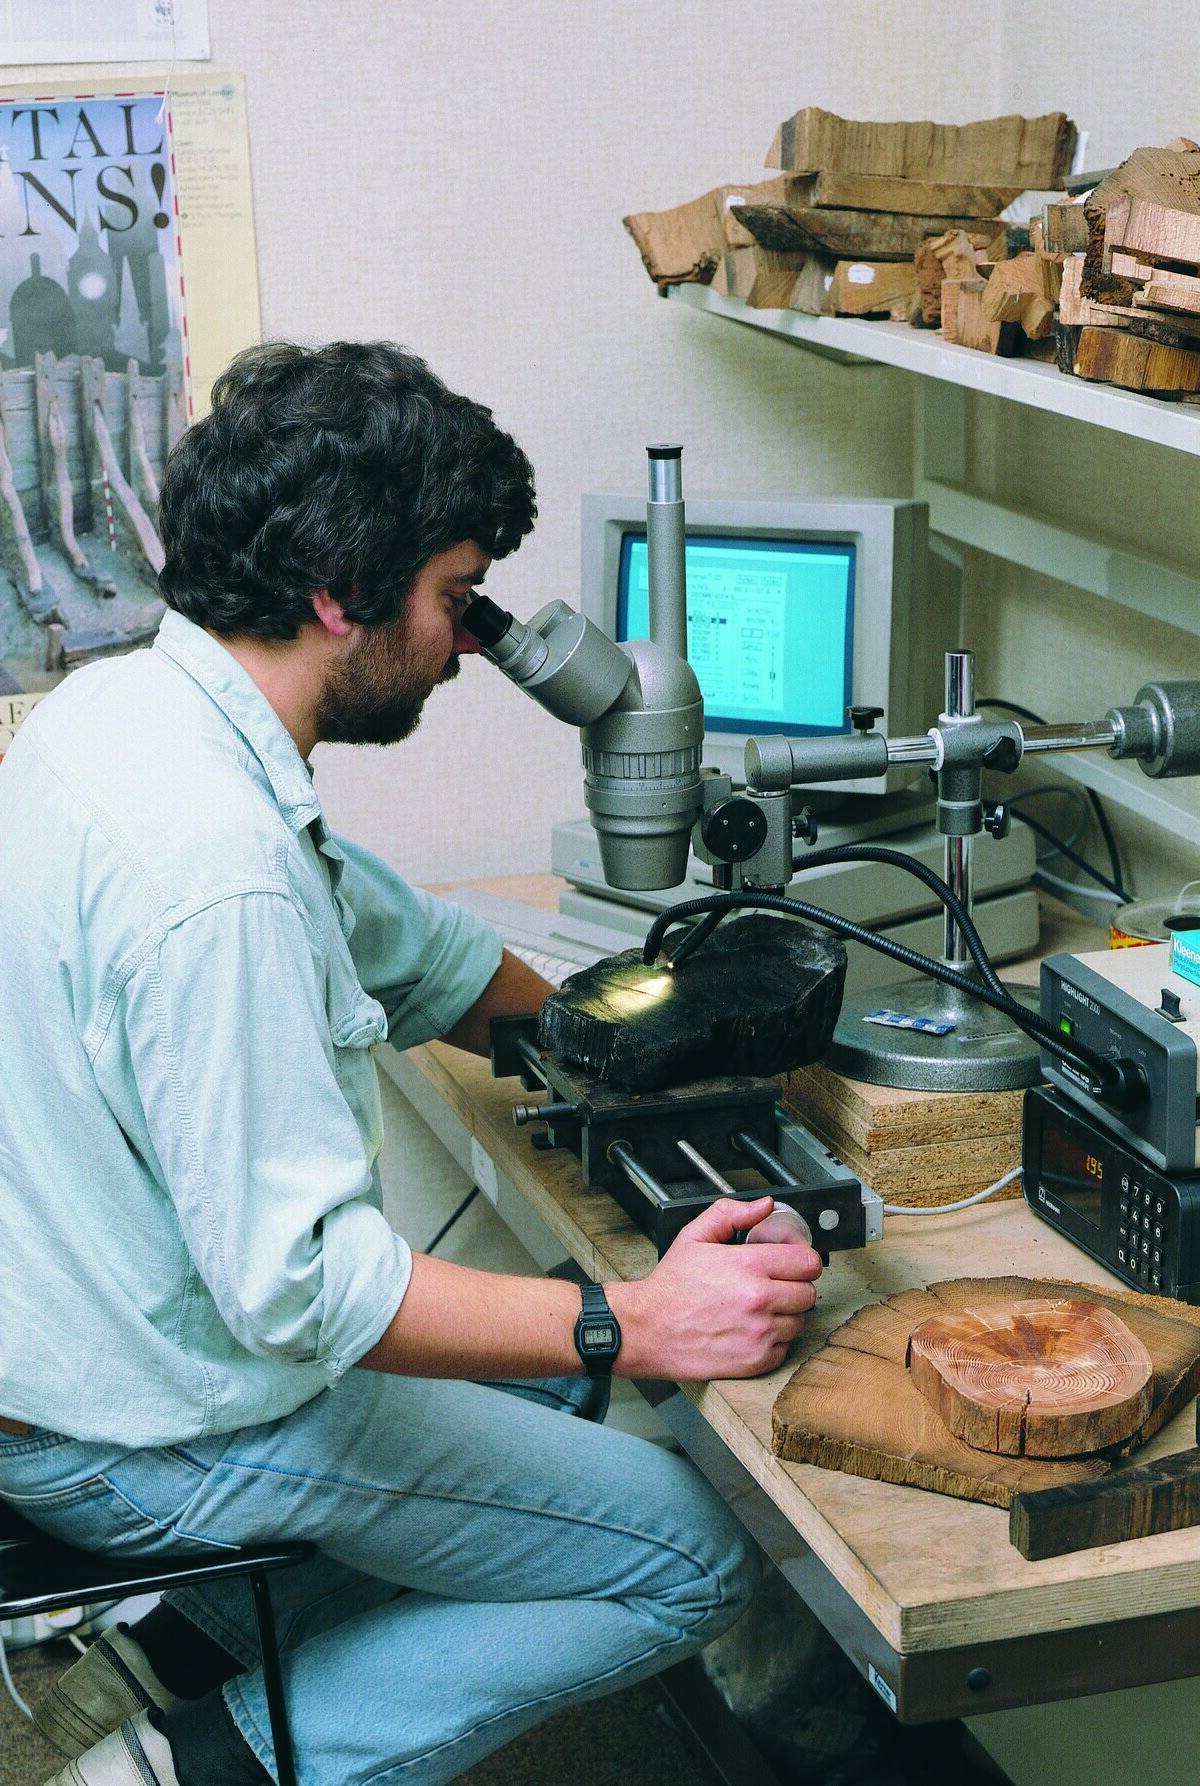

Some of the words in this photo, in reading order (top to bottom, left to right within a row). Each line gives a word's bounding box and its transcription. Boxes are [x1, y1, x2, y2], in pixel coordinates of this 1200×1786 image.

[0, 104, 164, 161] TAL
[0, 163, 169, 237] NS!
[1060, 980, 1089, 1008] HIGHLIGHT
[1089, 1000, 1101, 1016] 2000
[1087, 1155, 1103, 1180] 195
[1133, 1185, 1139, 1197] 7
[1145, 1194, 1151, 1205] 8
[1156, 1202, 1162, 1213] 9
[1132, 1210, 1138, 1223] 4
[1144, 1218, 1149, 1229] 5
[1155, 1227, 1161, 1238] 6
[1130, 1258, 1136, 1270] 0
[1143, 1242, 1148, 1254] 2
[1154, 1251, 1160, 1262] 3
